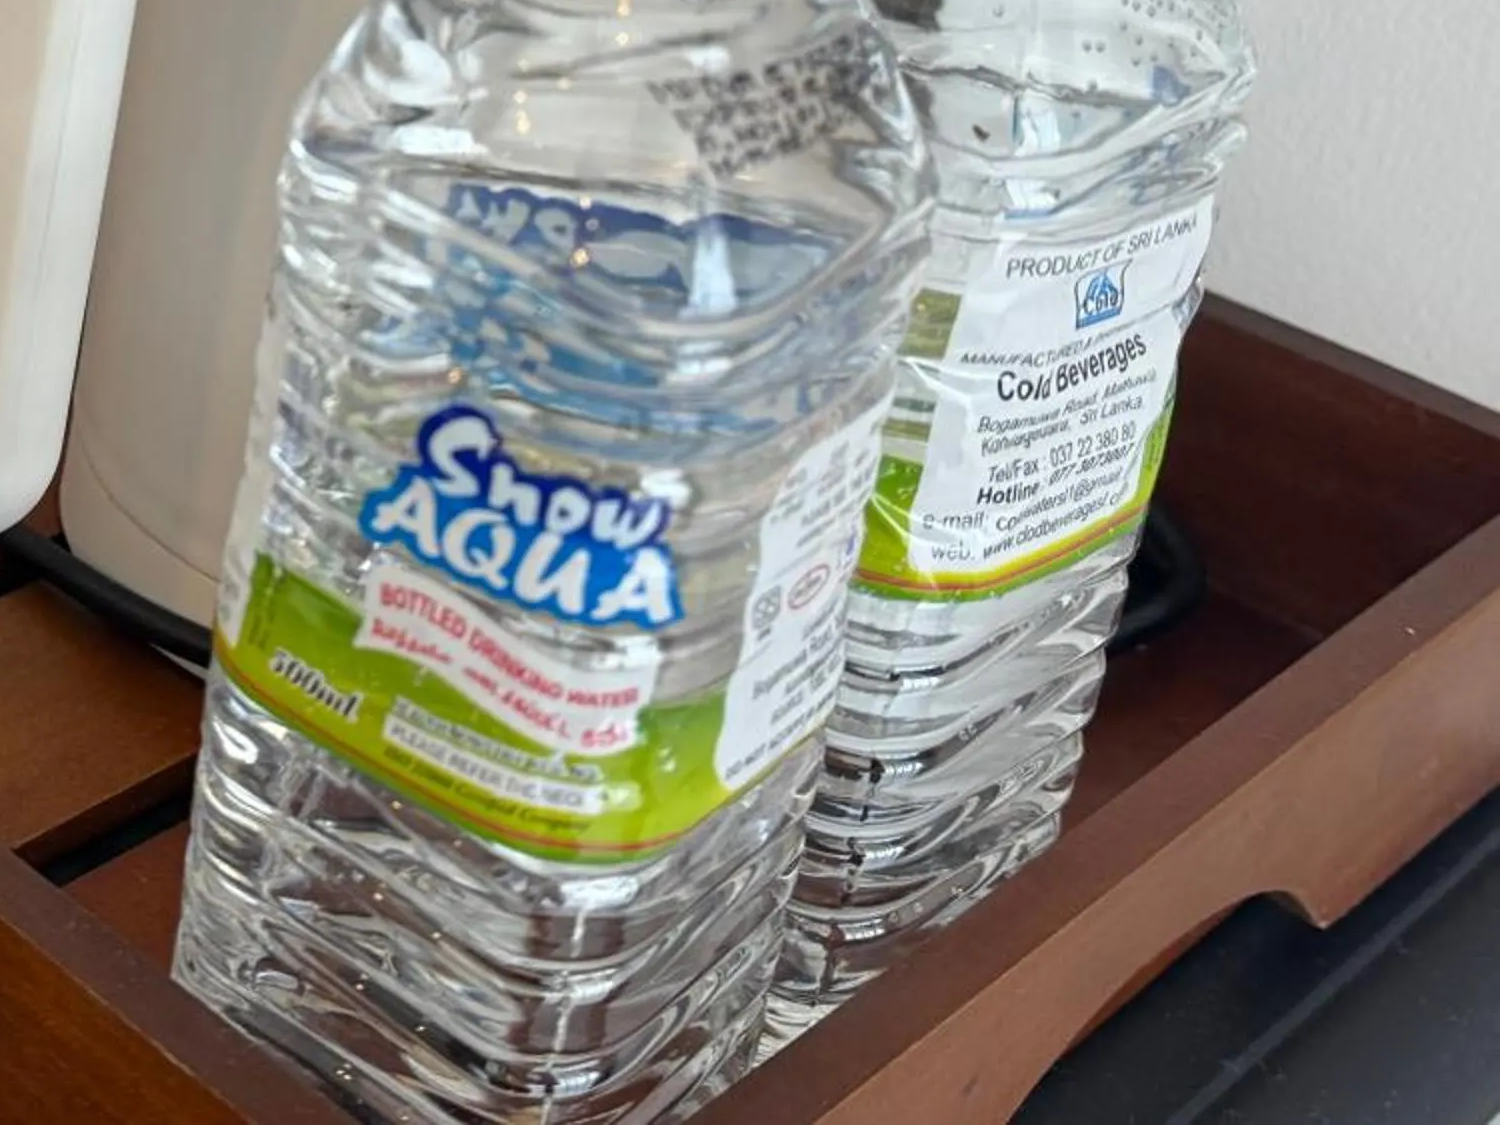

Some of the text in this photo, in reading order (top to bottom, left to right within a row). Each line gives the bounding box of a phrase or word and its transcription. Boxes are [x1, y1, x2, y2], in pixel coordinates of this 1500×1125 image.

[1006, 249, 1100, 278] PRODUCT
[1102, 240, 1126, 263] OF
[1126, 232, 1153, 255] SRI
[997, 369, 1052, 402] Cold
[1055, 332, 1147, 393] Beverages
[428, 415, 663, 551] Snow
[370, 475, 674, 624] AQUA
[380, 582, 468, 639] BOTTLED
[468, 627, 564, 700] DRINKING
[566, 686, 639, 708] WATER
